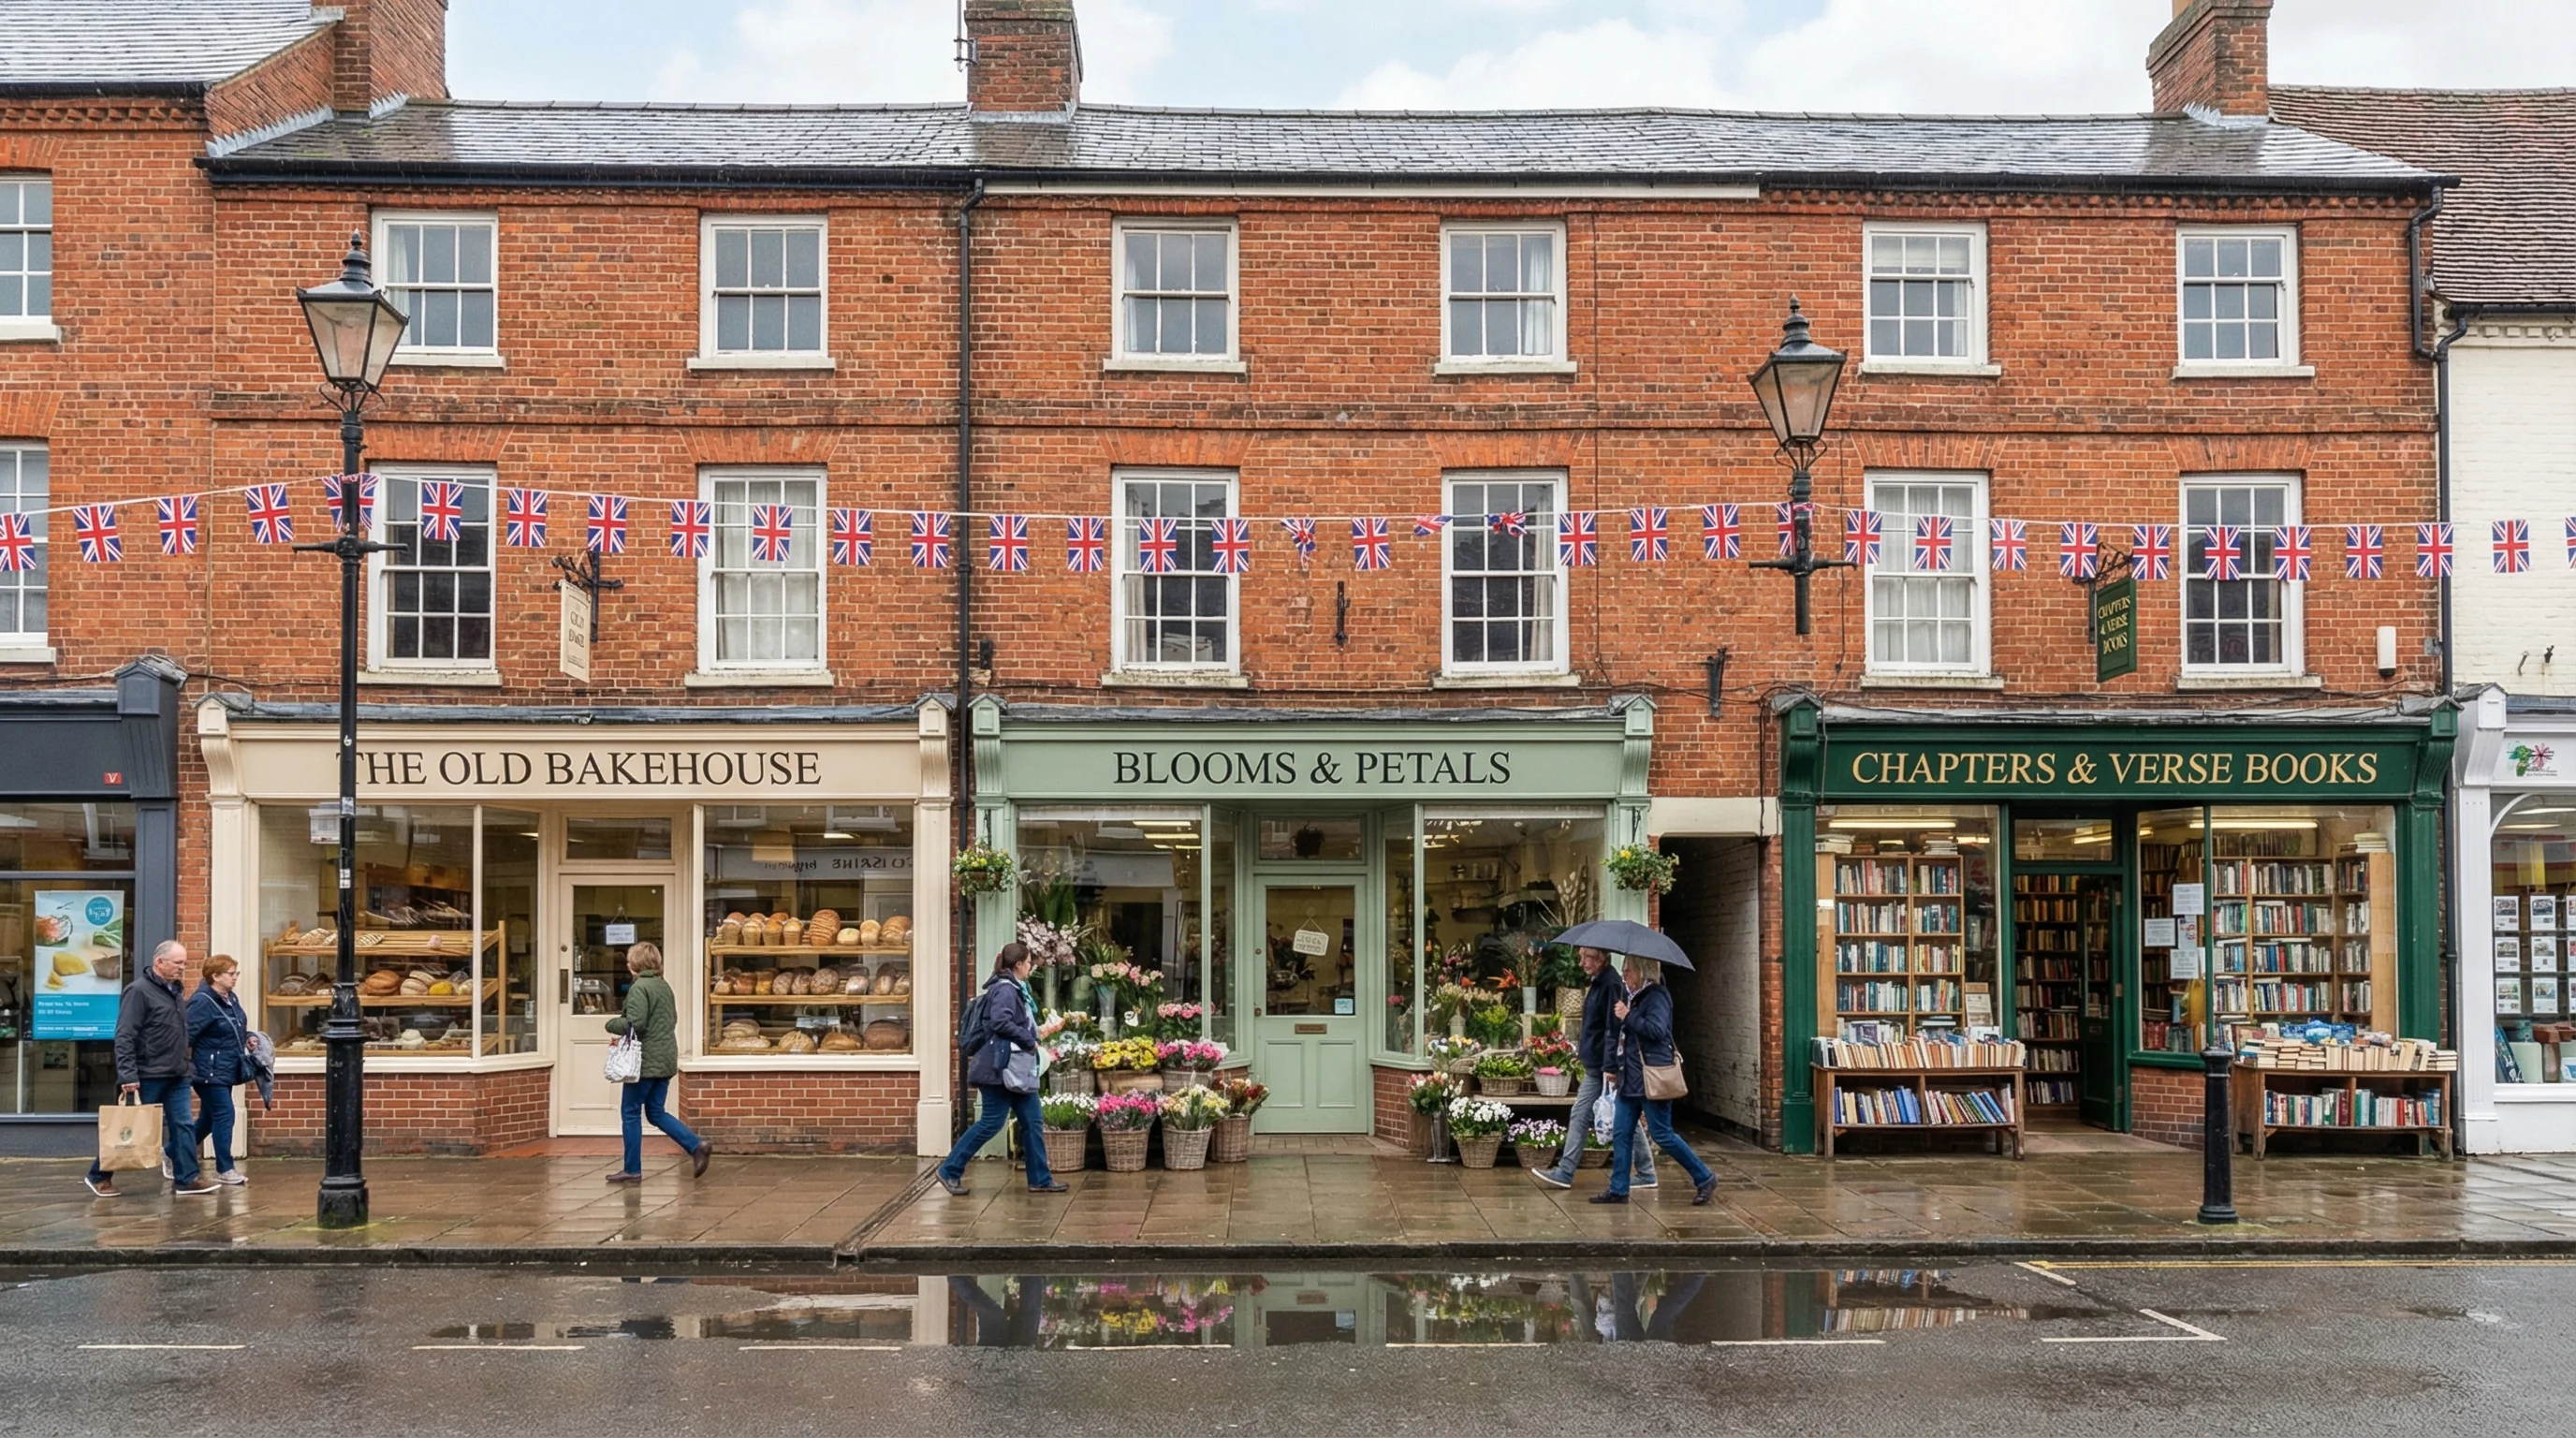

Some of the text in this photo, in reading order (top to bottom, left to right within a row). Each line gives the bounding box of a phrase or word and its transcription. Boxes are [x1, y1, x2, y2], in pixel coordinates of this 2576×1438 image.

[439, 752, 533, 785] OLD
[546, 752, 822, 785] BAKEHOUSE
[1113, 751, 1511, 785] BLOOMS & PETALS
[1852, 752, 2378, 785] CHAPTERS & VERSE BOOKS
